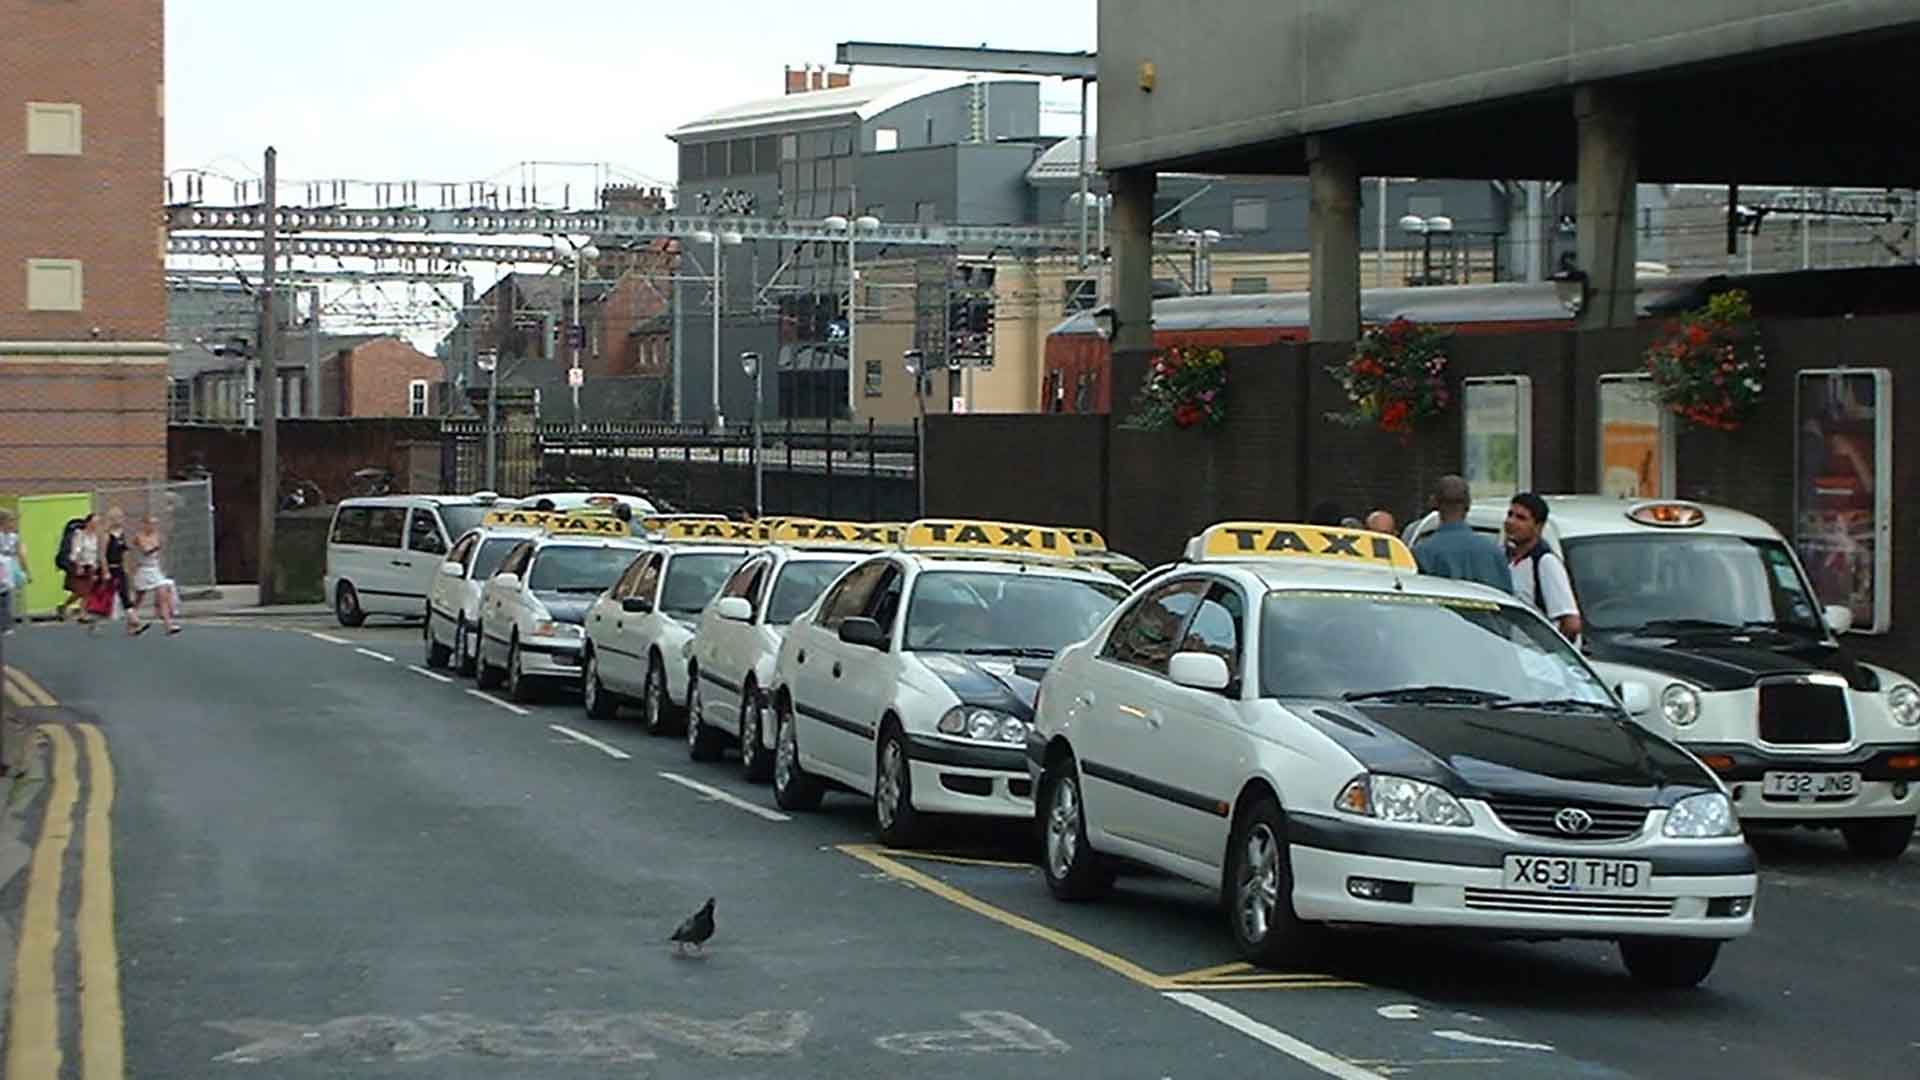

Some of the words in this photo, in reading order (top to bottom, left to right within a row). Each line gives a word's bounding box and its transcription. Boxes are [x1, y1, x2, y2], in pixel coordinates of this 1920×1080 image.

[493, 512, 549, 524] TAX
[554, 517, 623, 532] TAXI
[680, 522, 770, 539] TAXI
[791, 523, 899, 545] TAXI
[923, 523, 1056, 549] TAXI
[1225, 527, 1392, 559] TAXI
[1774, 775, 1811, 792] T32
[1514, 858, 1576, 884] X631
[1586, 862, 1638, 888] THD
